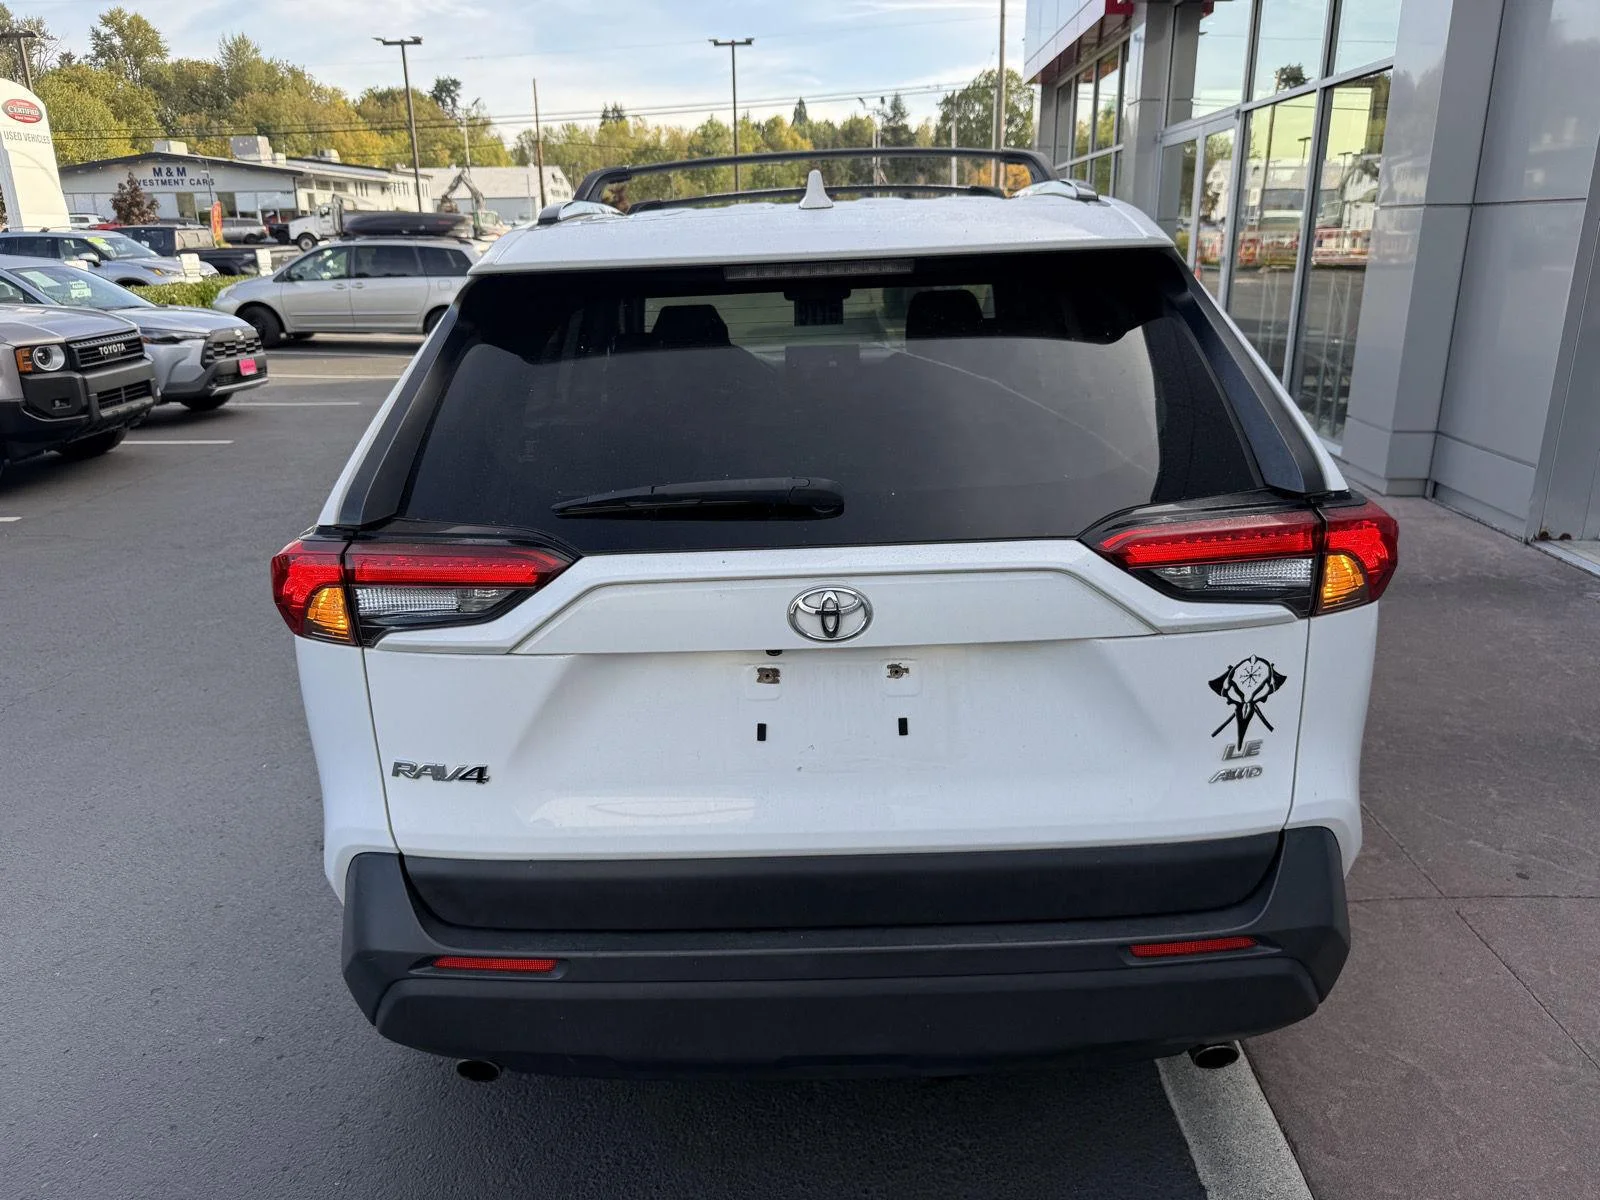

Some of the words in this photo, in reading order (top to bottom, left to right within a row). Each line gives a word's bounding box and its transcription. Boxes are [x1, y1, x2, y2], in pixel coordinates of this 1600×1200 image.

[3, 130, 22, 141] USED
[22, 132, 51, 144] VEHICLES
[152, 166, 163, 177] M
[165, 167, 174, 177] &
[176, 166, 187, 177] M
[132, 178, 185, 187] VESTMENT
[189, 178, 215, 186] CARS
[98, 342, 127, 355] TOYOTA
[1222, 739, 1263, 761] LE
[391, 760, 490, 784] RAV4
[1208, 765, 1263, 784] AWD
